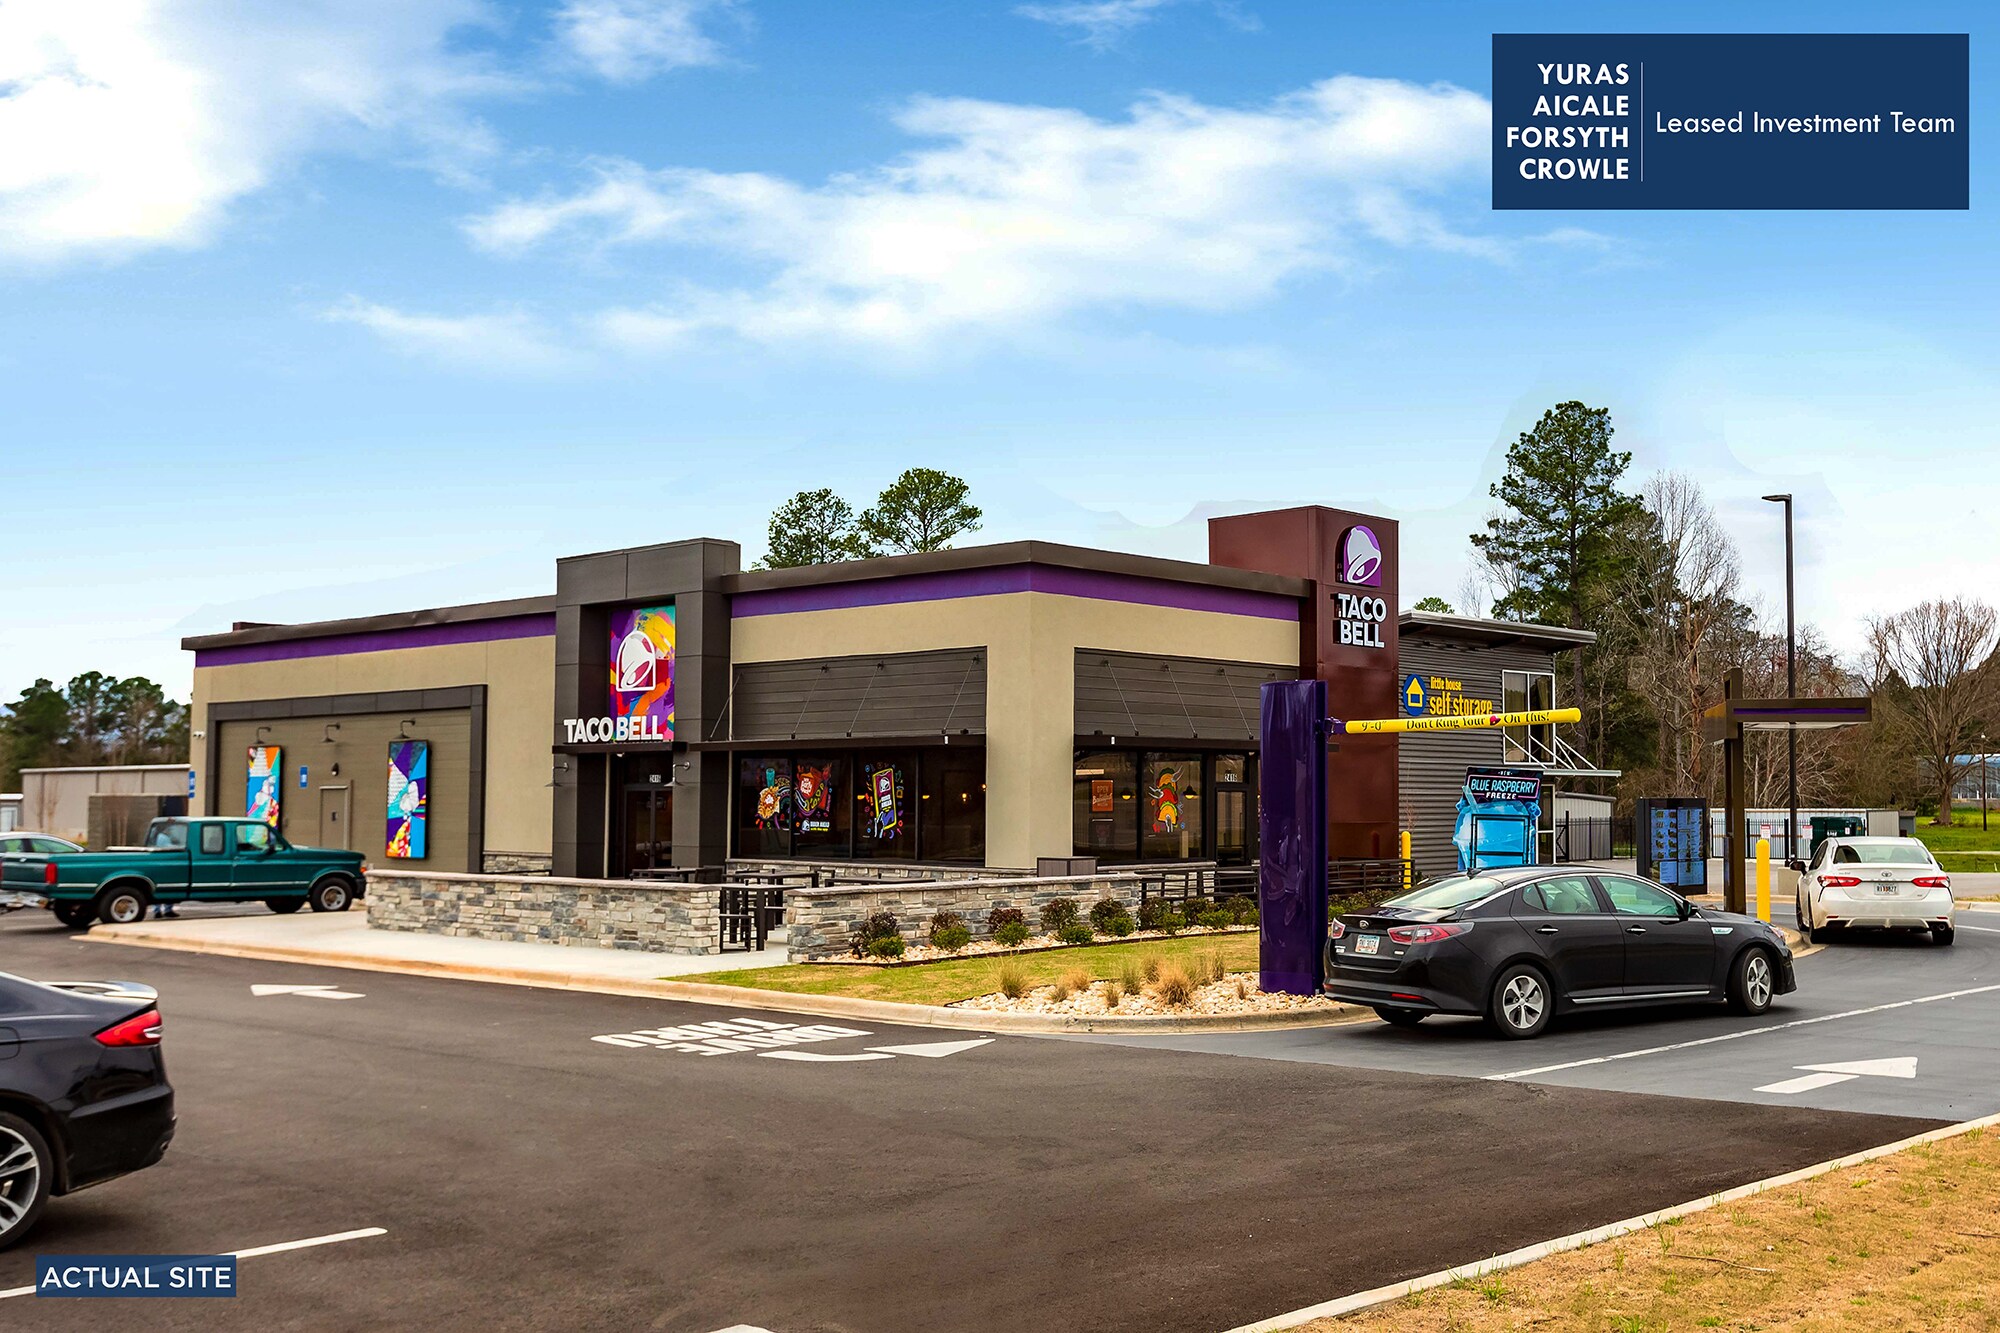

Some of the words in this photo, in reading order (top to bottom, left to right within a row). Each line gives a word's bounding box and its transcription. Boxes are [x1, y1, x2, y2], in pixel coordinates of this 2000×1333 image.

[1338, 593, 1387, 623] TACO
[1340, 619, 1385, 648] BELL
[1430, 676, 1445, 690] little
[1445, 677, 1462, 691] house
[1429, 691, 1451, 715] self
[1452, 694, 1493, 716] storage
[563, 716, 614, 744] TACO
[616, 715, 664, 741] BELL
[1406, 719, 1434, 730] Don't
[1435, 718, 1460, 730] Ring
[1462, 717, 1486, 727] Your
[1503, 714, 1521, 724] On
[1525, 711, 1550, 723] This!
[1470, 778, 1491, 791] BLUE
[1491, 780, 1537, 794] RASPBERRY
[1485, 791, 1517, 800] FREEZE
[590, 1017, 801, 1048] THRU
[655, 1024, 875, 1057] DRIVE
